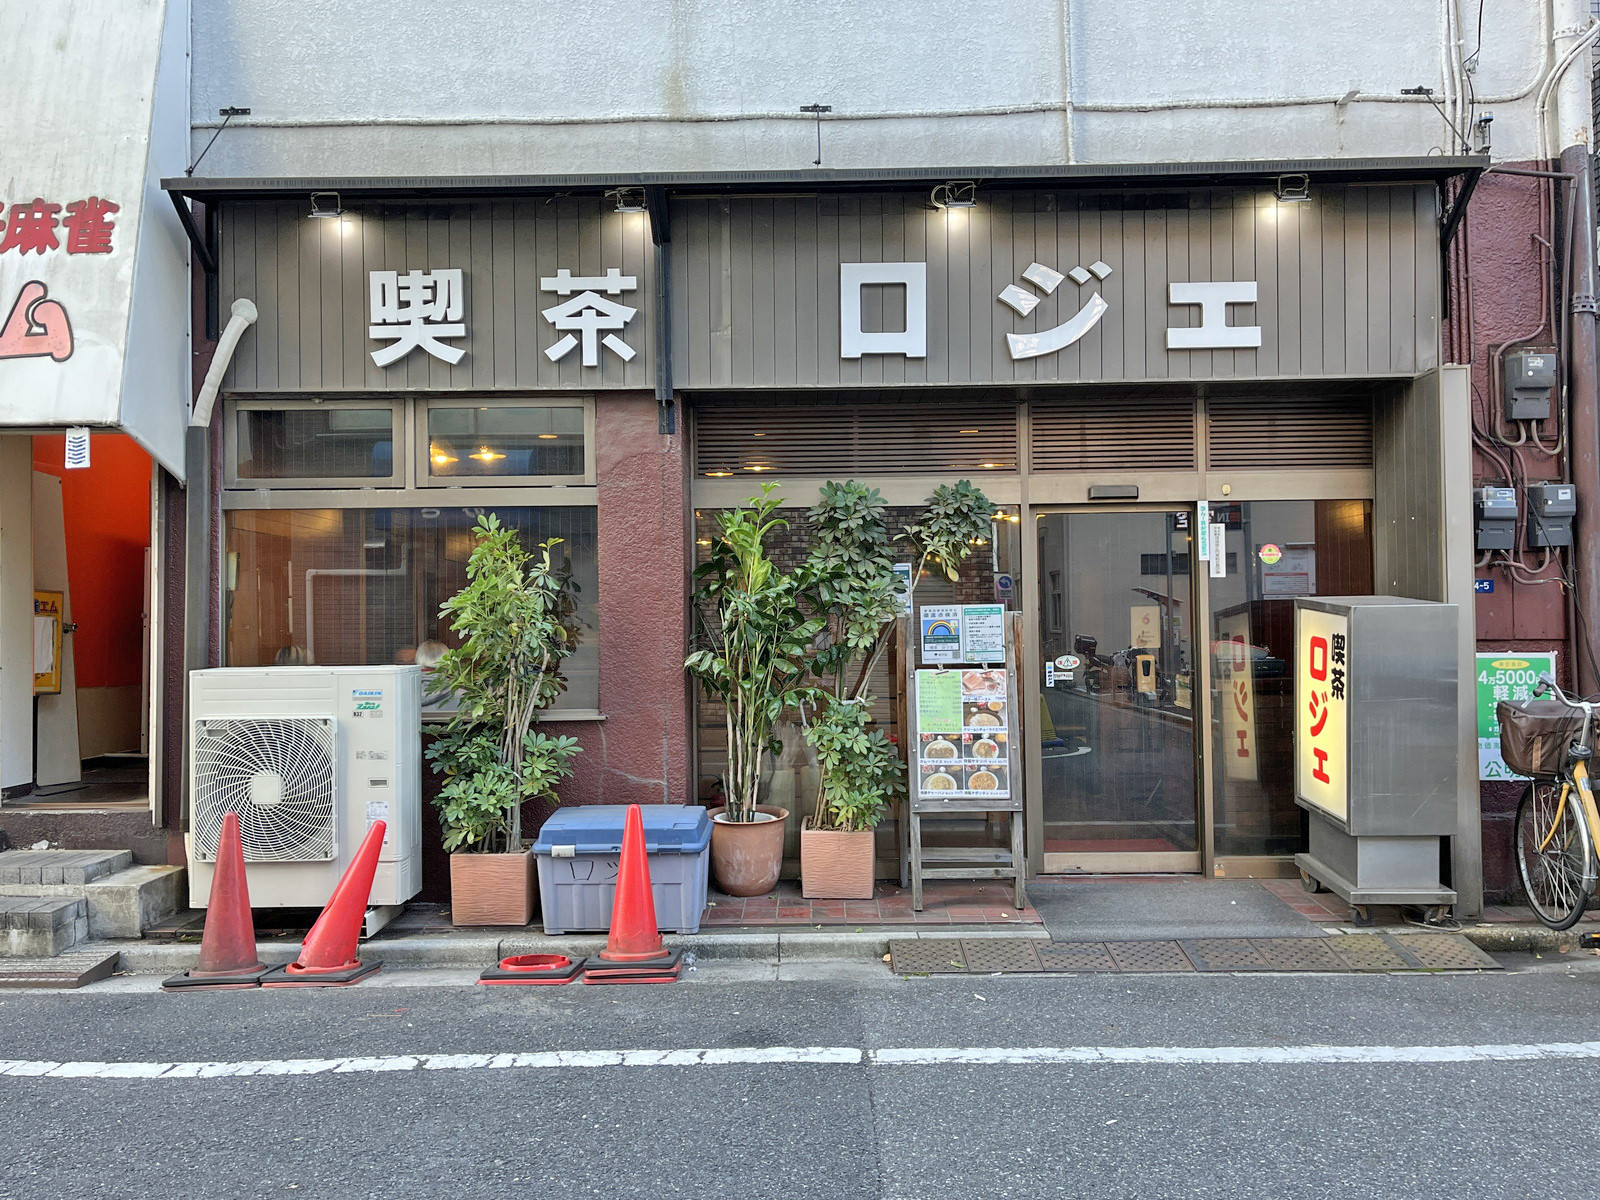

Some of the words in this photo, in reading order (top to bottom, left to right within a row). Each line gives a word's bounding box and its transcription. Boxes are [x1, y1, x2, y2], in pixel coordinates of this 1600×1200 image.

[0, 196, 120, 256] 麻雀
[368, 268, 638, 367] 喫茶
[1331, 633, 1346, 701] 喫茶
